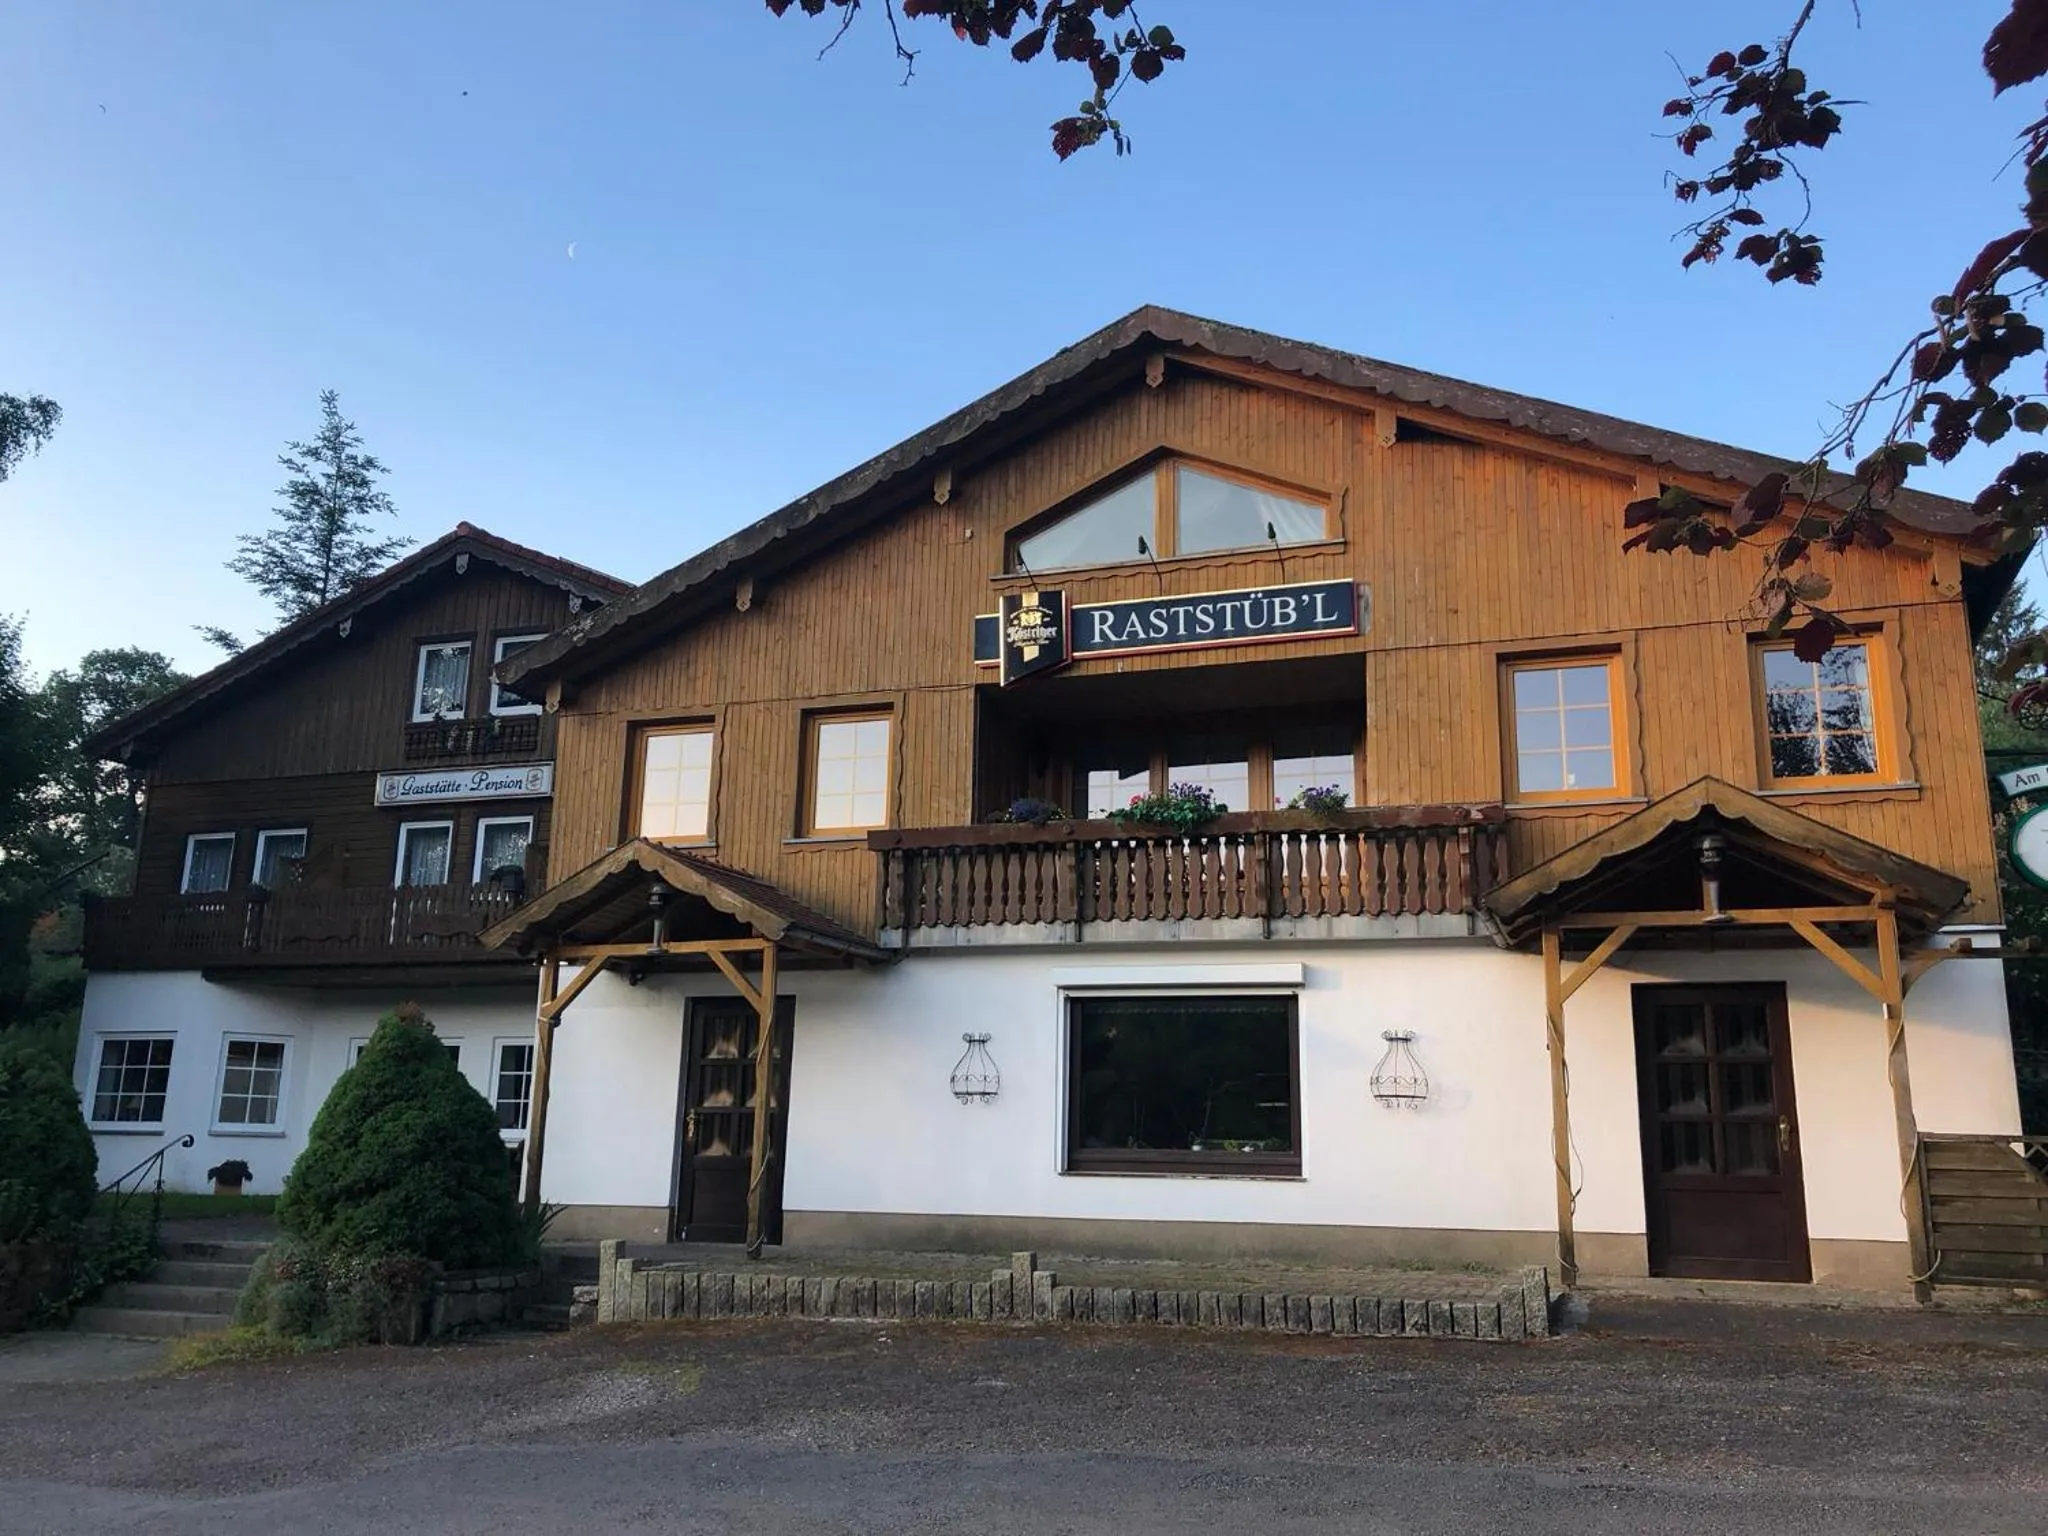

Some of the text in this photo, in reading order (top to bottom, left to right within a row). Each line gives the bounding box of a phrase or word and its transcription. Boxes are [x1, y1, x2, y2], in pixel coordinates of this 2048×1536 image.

[1091, 592, 1338, 643] RASTSTÜB'L
[400, 776, 462, 796] Gaststätte
[470, 770, 523, 792] Pension
[2015, 773, 2040, 787] Am
